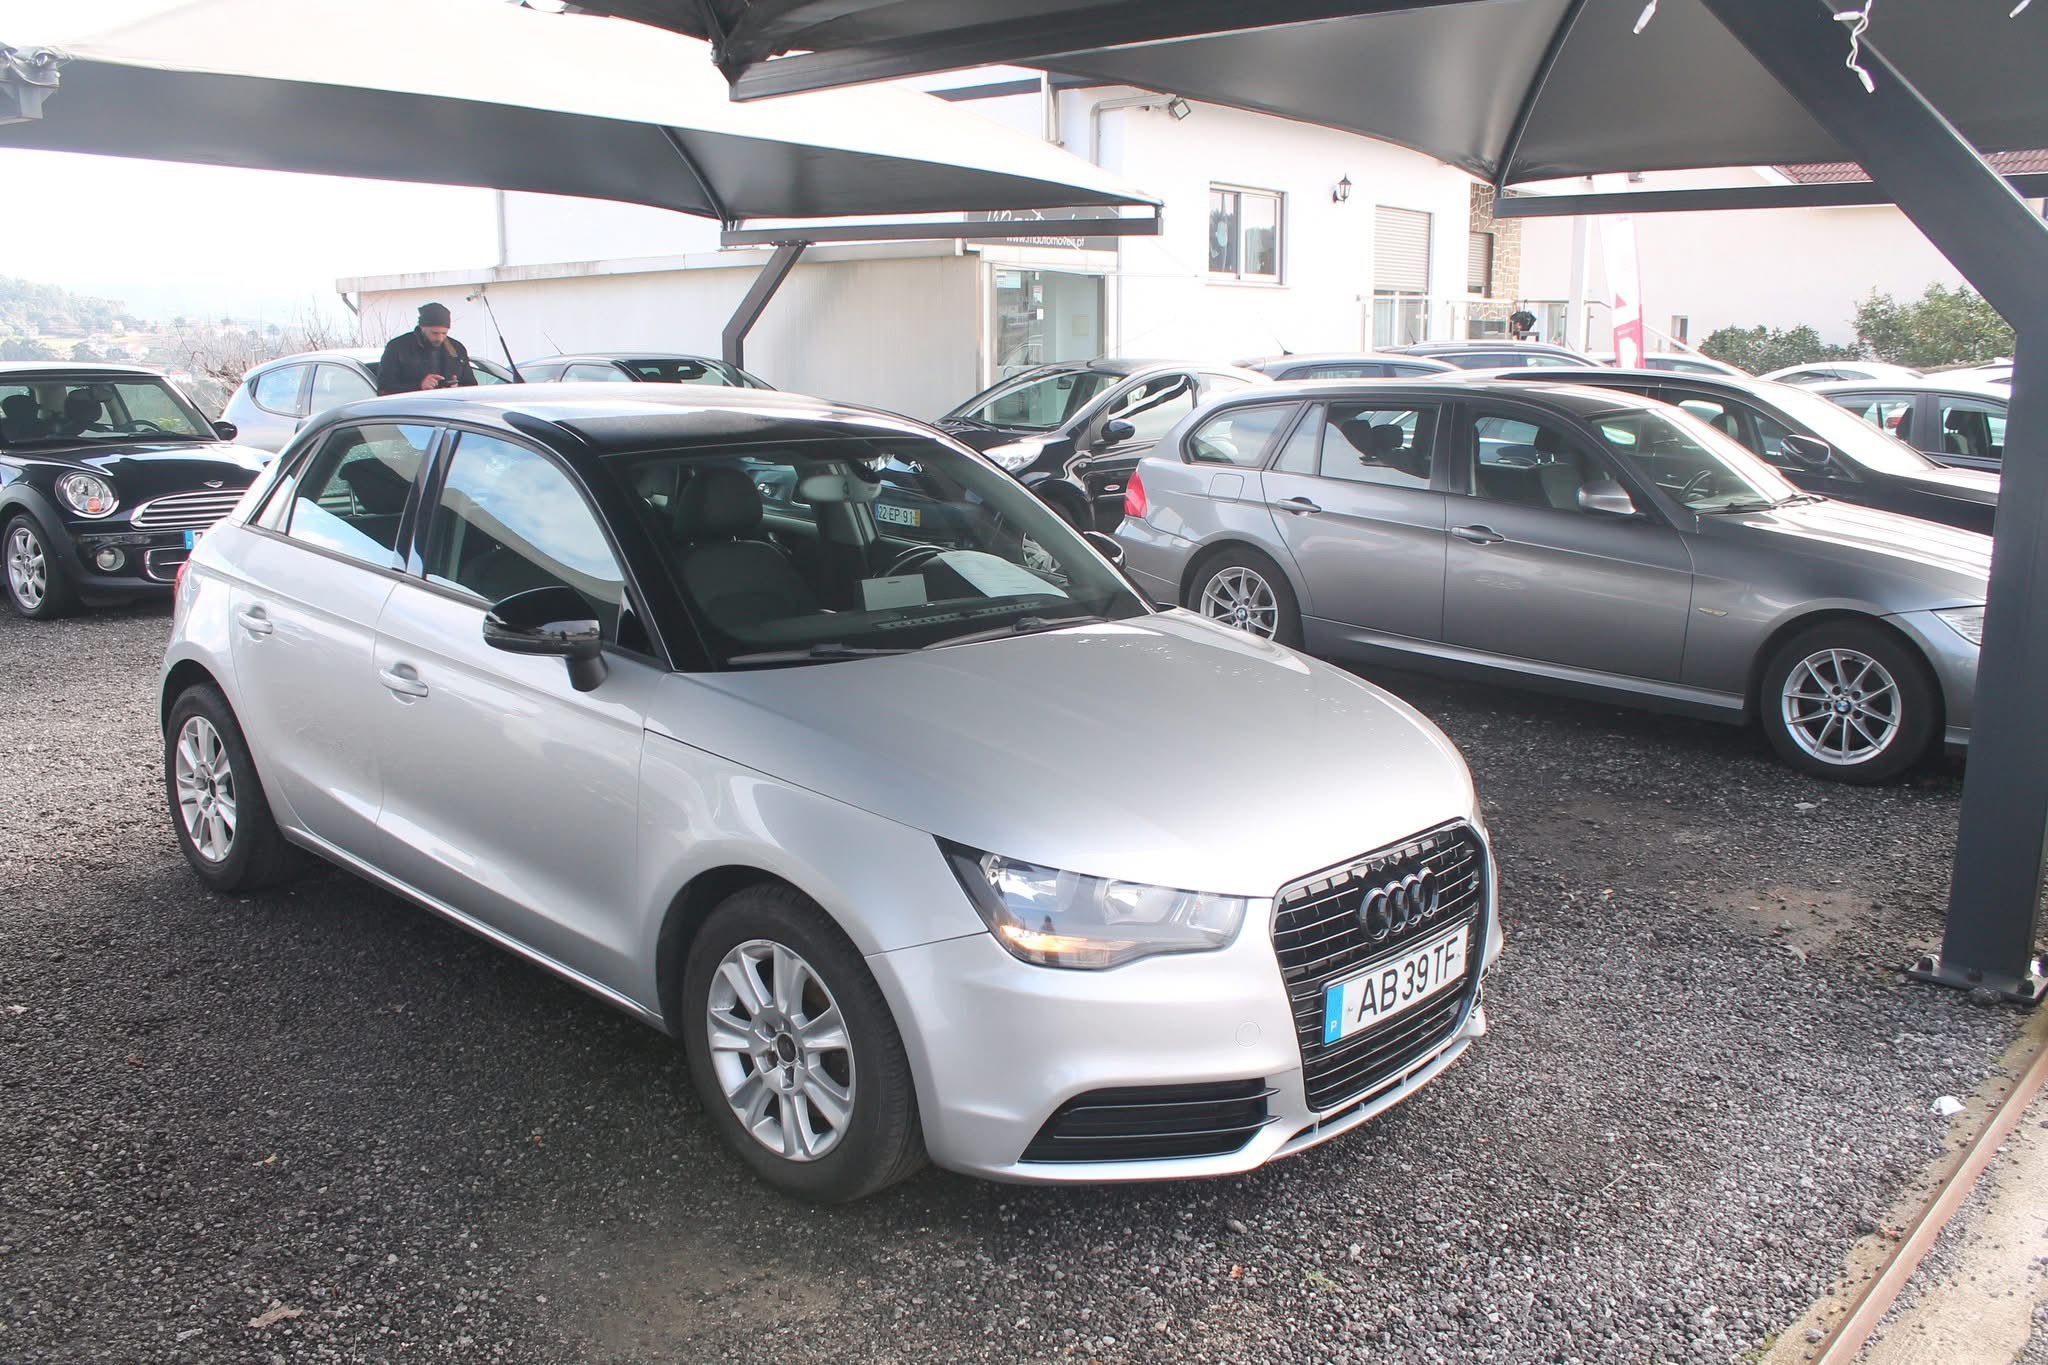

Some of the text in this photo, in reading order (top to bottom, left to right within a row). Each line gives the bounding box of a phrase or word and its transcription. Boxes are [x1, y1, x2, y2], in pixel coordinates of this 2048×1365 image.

[1357, 935, 1458, 1023] AB 39 TF
[1330, 1020, 1338, 1032] P
